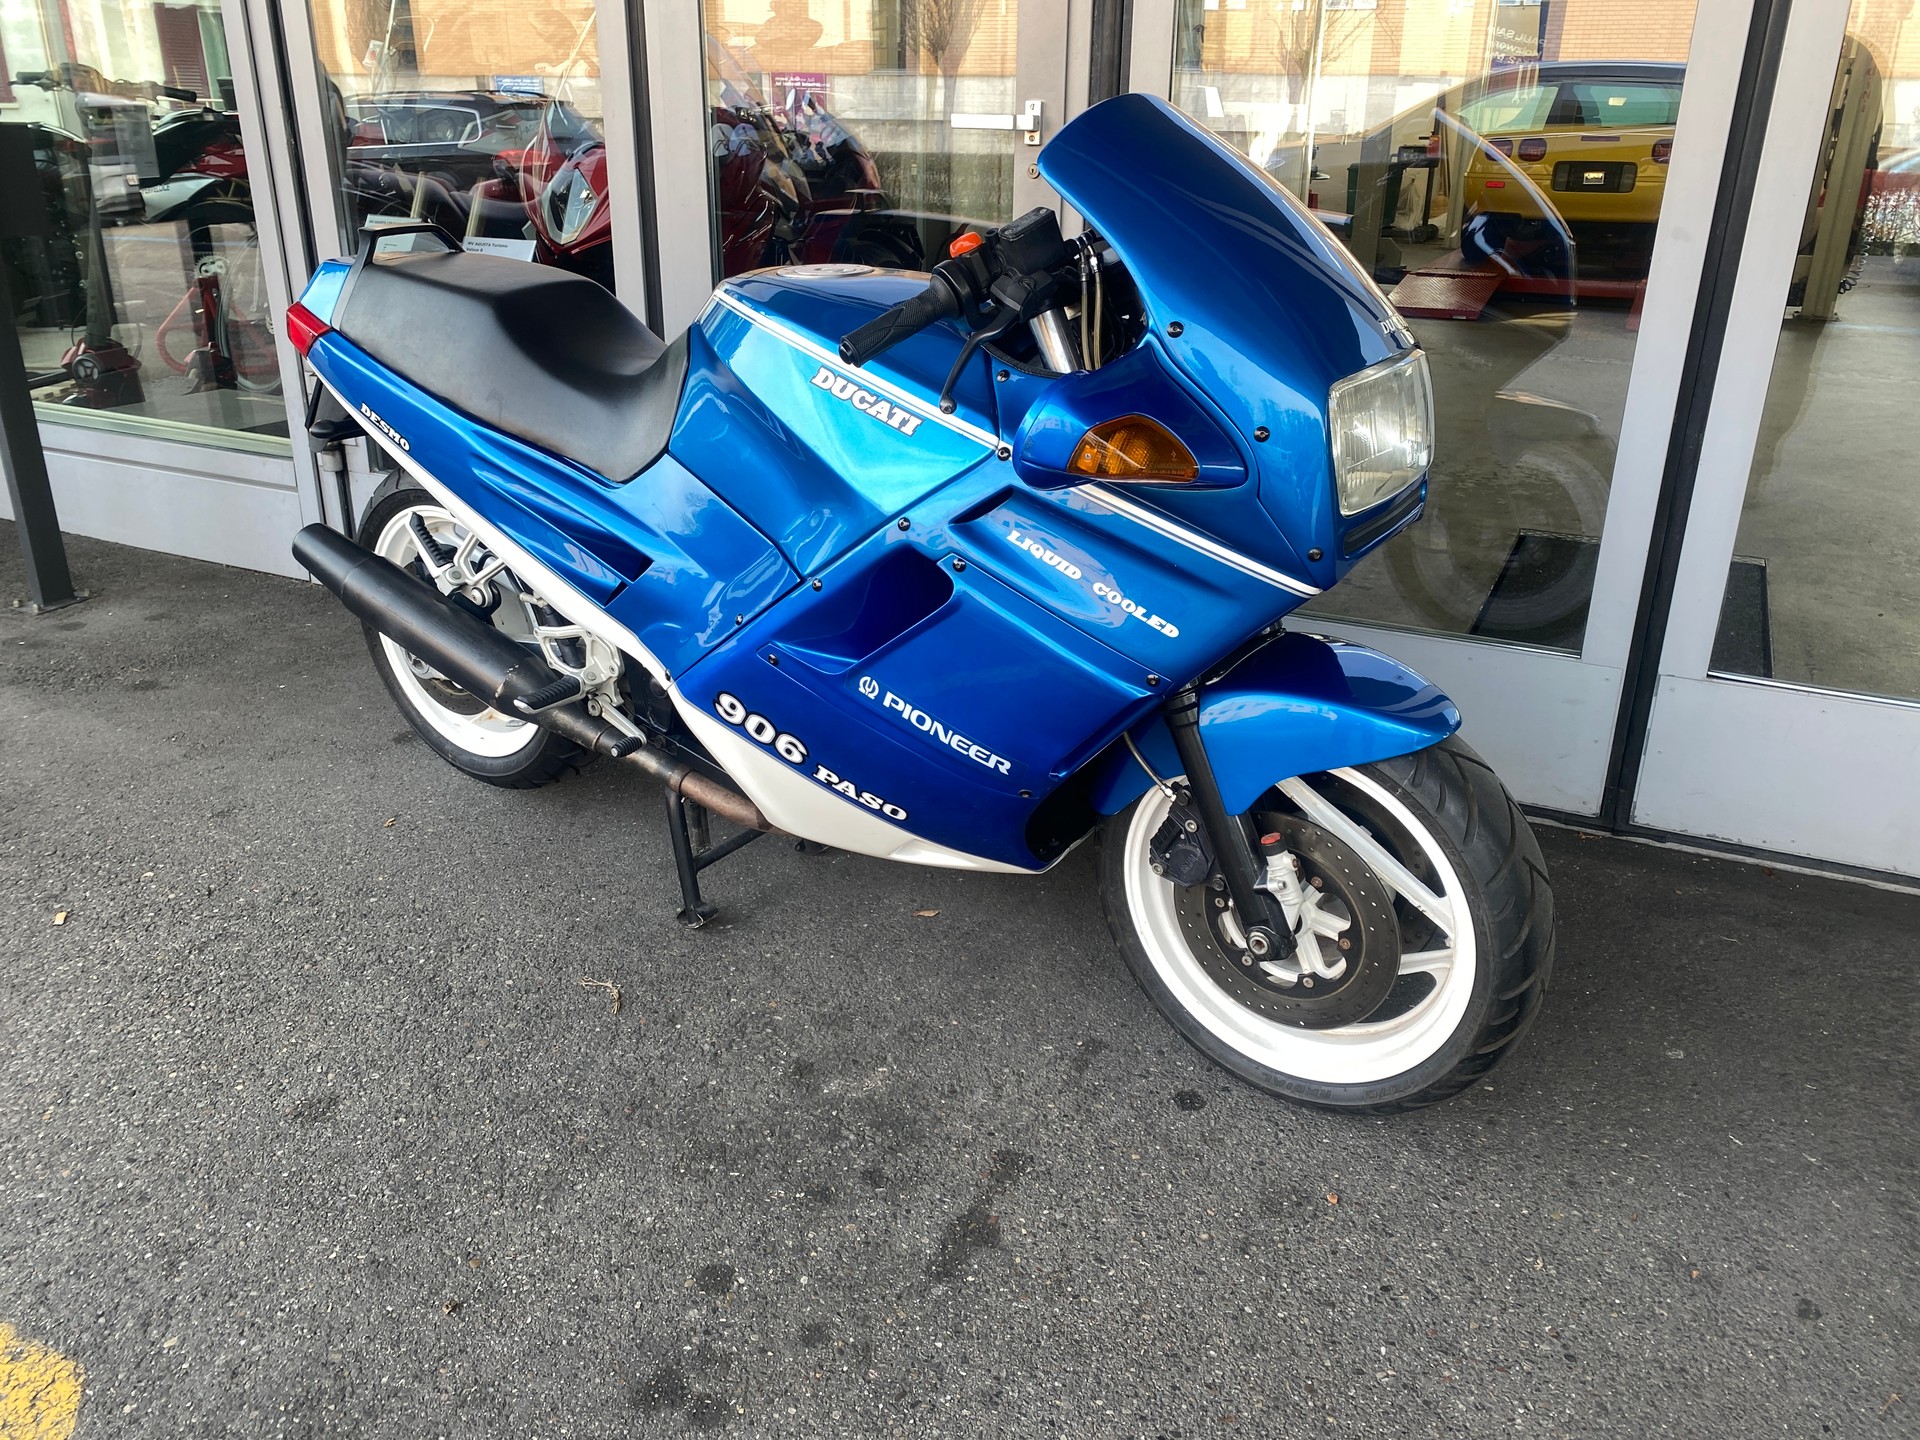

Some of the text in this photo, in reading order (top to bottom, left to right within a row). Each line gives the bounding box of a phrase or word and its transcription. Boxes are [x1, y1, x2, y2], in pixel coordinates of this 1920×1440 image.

[360, 401, 411, 452] DESMO
[809, 365, 926, 437] DUCATI
[1007, 530, 1180, 638] LIQUID COOLED
[713, 691, 909, 822] 906 PASO
[883, 691, 1012, 776] PIONEER
